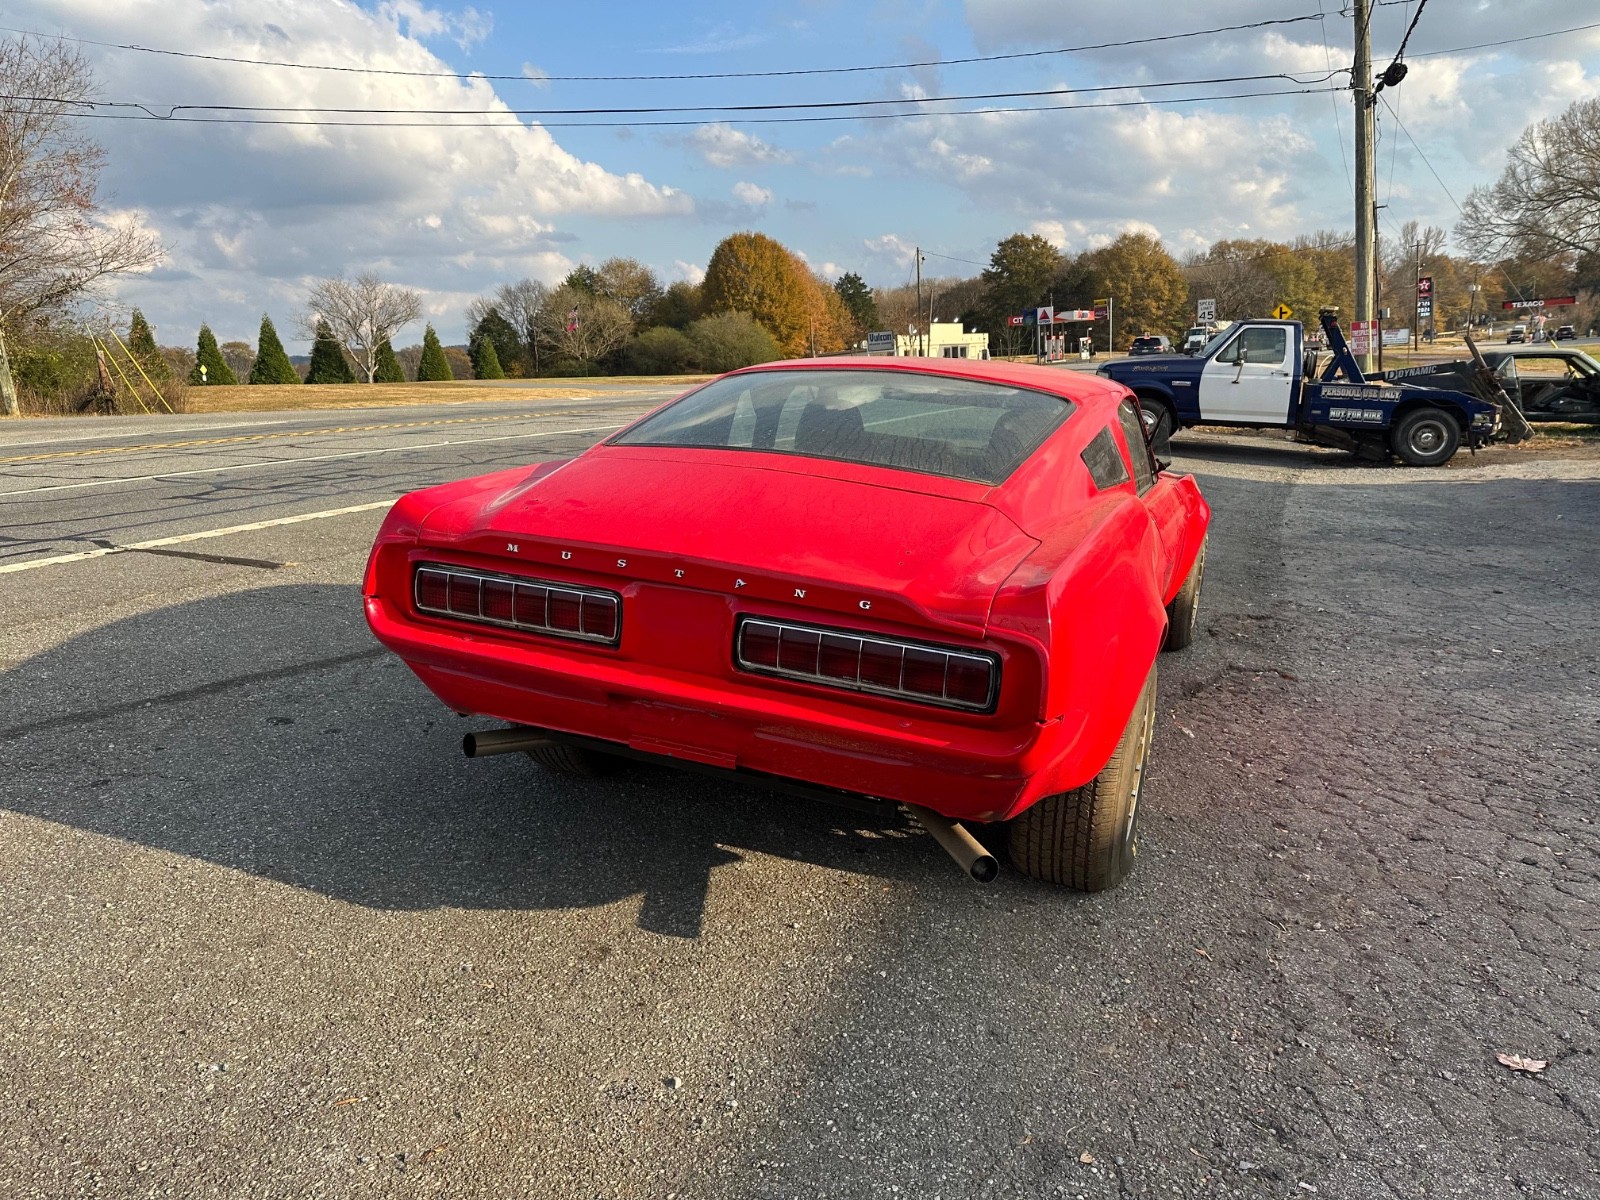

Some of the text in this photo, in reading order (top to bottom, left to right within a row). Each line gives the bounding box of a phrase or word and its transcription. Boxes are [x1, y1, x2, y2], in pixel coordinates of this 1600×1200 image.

[1512, 300, 1544, 308] TEXACO
[1199, 311, 1214, 320] 45
[1398, 365, 1437, 378] DYNAMIC
[1321, 386, 1402, 402] PERSONAL USE ONLY
[1329, 408, 1383, 423] NOT FOR HIRE
[506, 543, 871, 610] MUSTANG
